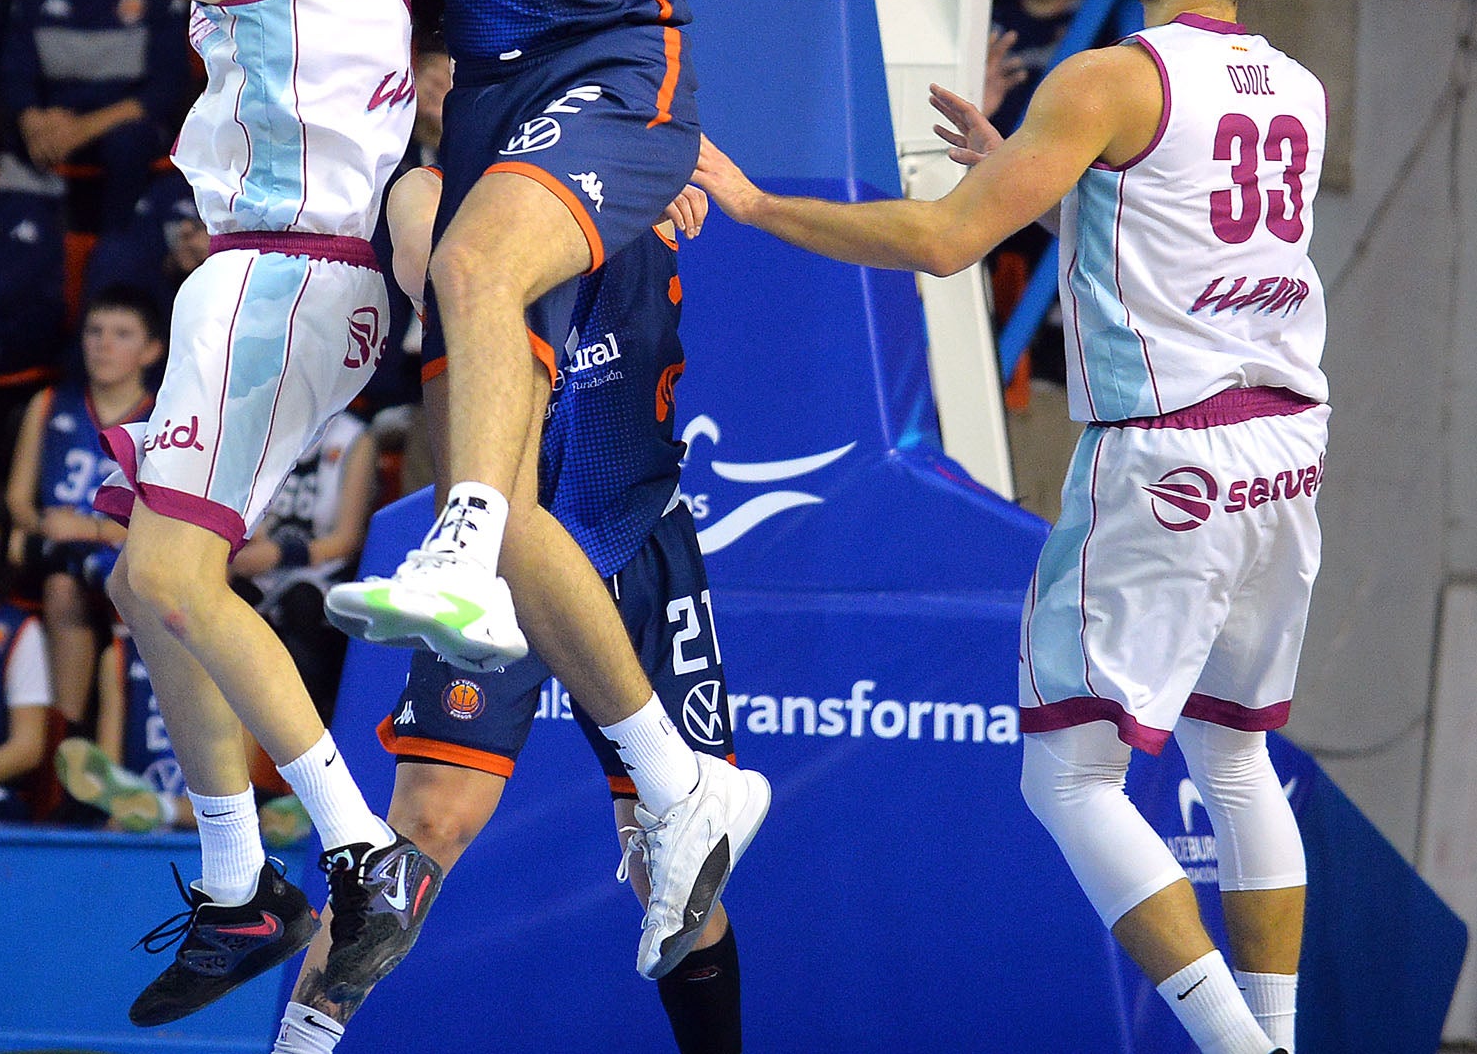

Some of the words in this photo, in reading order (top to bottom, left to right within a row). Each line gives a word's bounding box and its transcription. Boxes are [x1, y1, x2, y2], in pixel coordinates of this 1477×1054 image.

[1226, 64, 1276, 96] DJOLE
[1209, 113, 1309, 244] 33
[666, 589, 722, 676] 21
[727, 679, 1021, 745] ransforma
